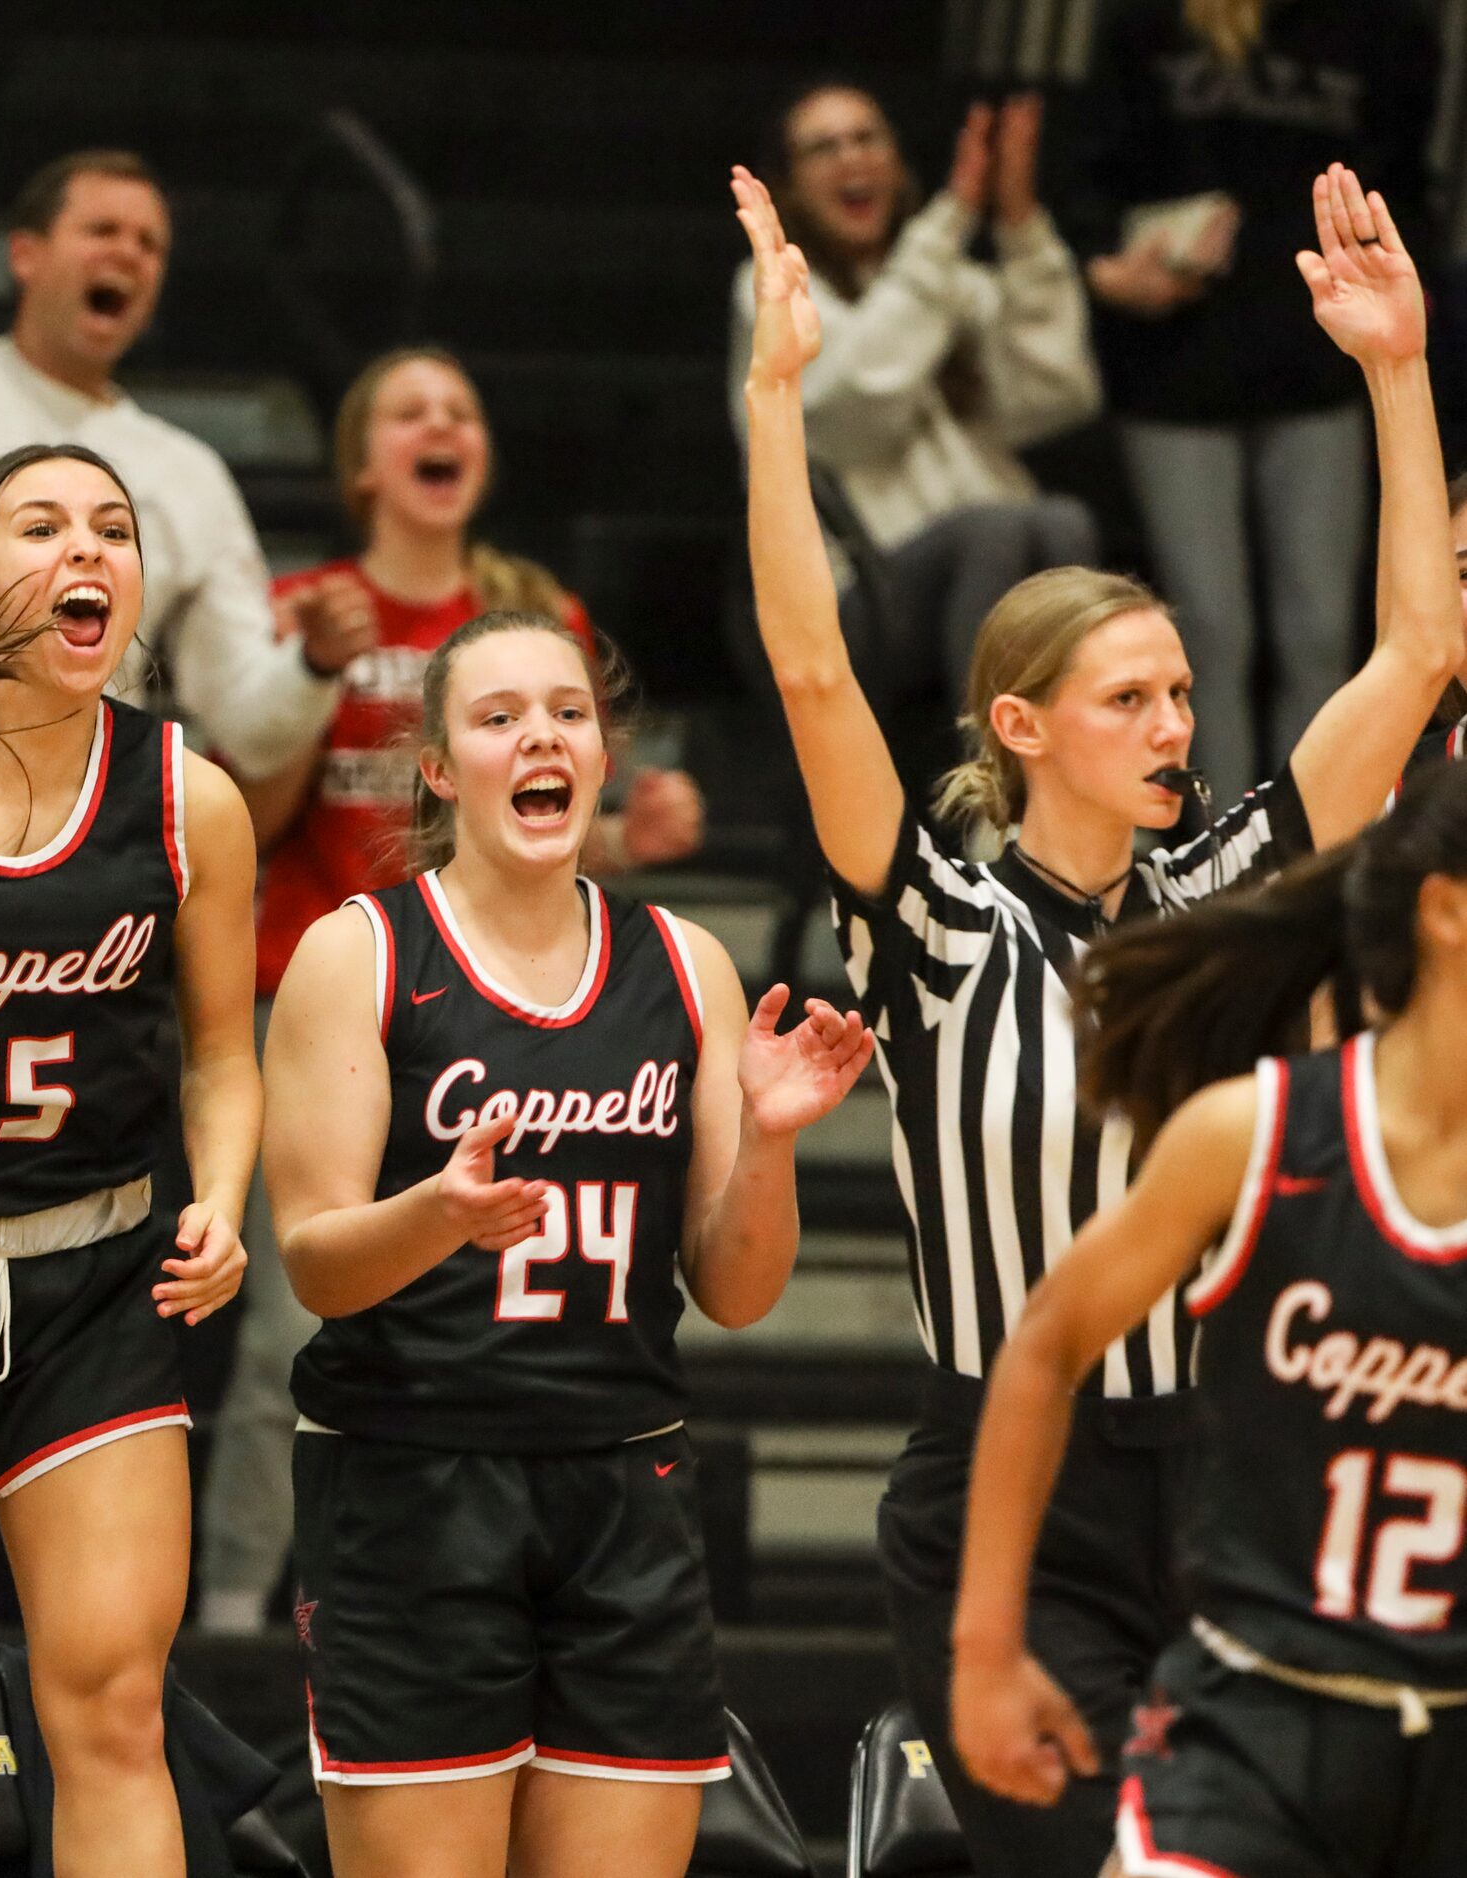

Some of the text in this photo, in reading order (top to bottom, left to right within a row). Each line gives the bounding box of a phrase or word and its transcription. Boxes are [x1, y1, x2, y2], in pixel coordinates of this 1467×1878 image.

[425, 1058, 679, 1155] Coppell
[494, 1179, 640, 1324] 24
[1312, 1446, 1467, 1633] 12
